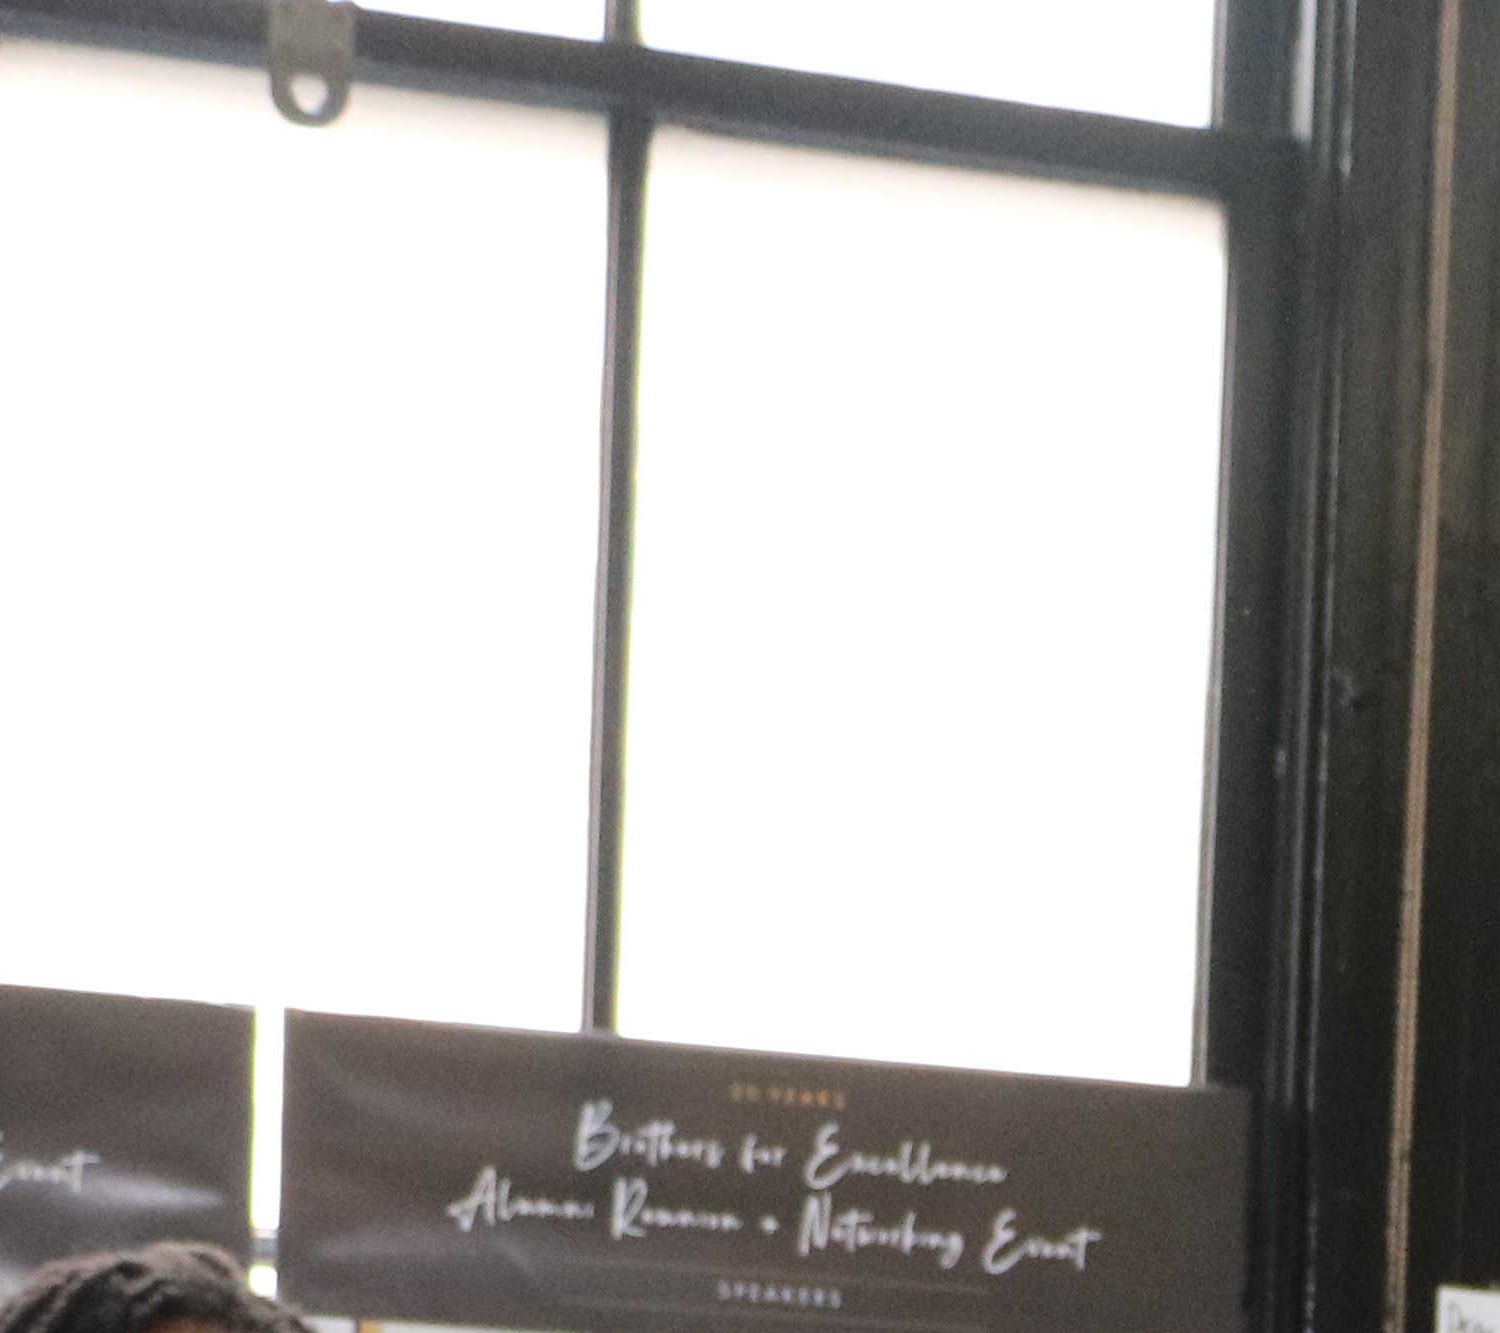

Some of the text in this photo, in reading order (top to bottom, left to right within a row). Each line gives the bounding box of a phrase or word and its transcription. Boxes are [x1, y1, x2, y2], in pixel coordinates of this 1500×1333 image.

[573, 1100, 1008, 1189] Brothers for Excellence
[447, 1166, 595, 1232] Alumni
[798, 1193, 965, 1268] Networking
[981, 1209, 1102, 1275] Event
[714, 1278, 844, 1310] SPEAKERS
